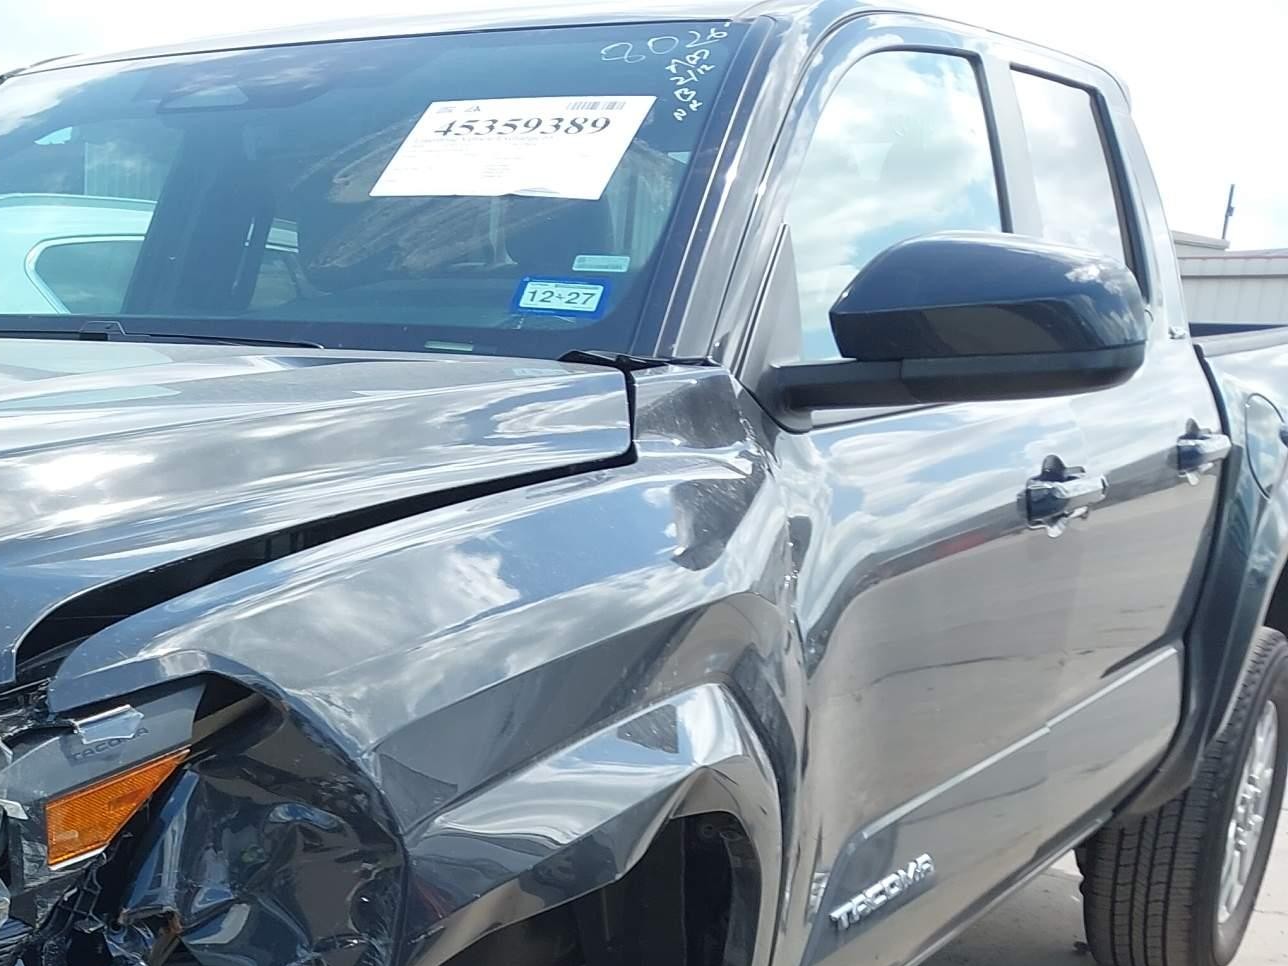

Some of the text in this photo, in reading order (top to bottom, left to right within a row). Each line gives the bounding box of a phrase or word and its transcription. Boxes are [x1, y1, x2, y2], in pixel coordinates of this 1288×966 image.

[432, 116, 612, 137] 45359389
[527, 288, 598, 306] 12 27
[71, 726, 150, 762] TACOA
[827, 852, 935, 931] TACOMA
